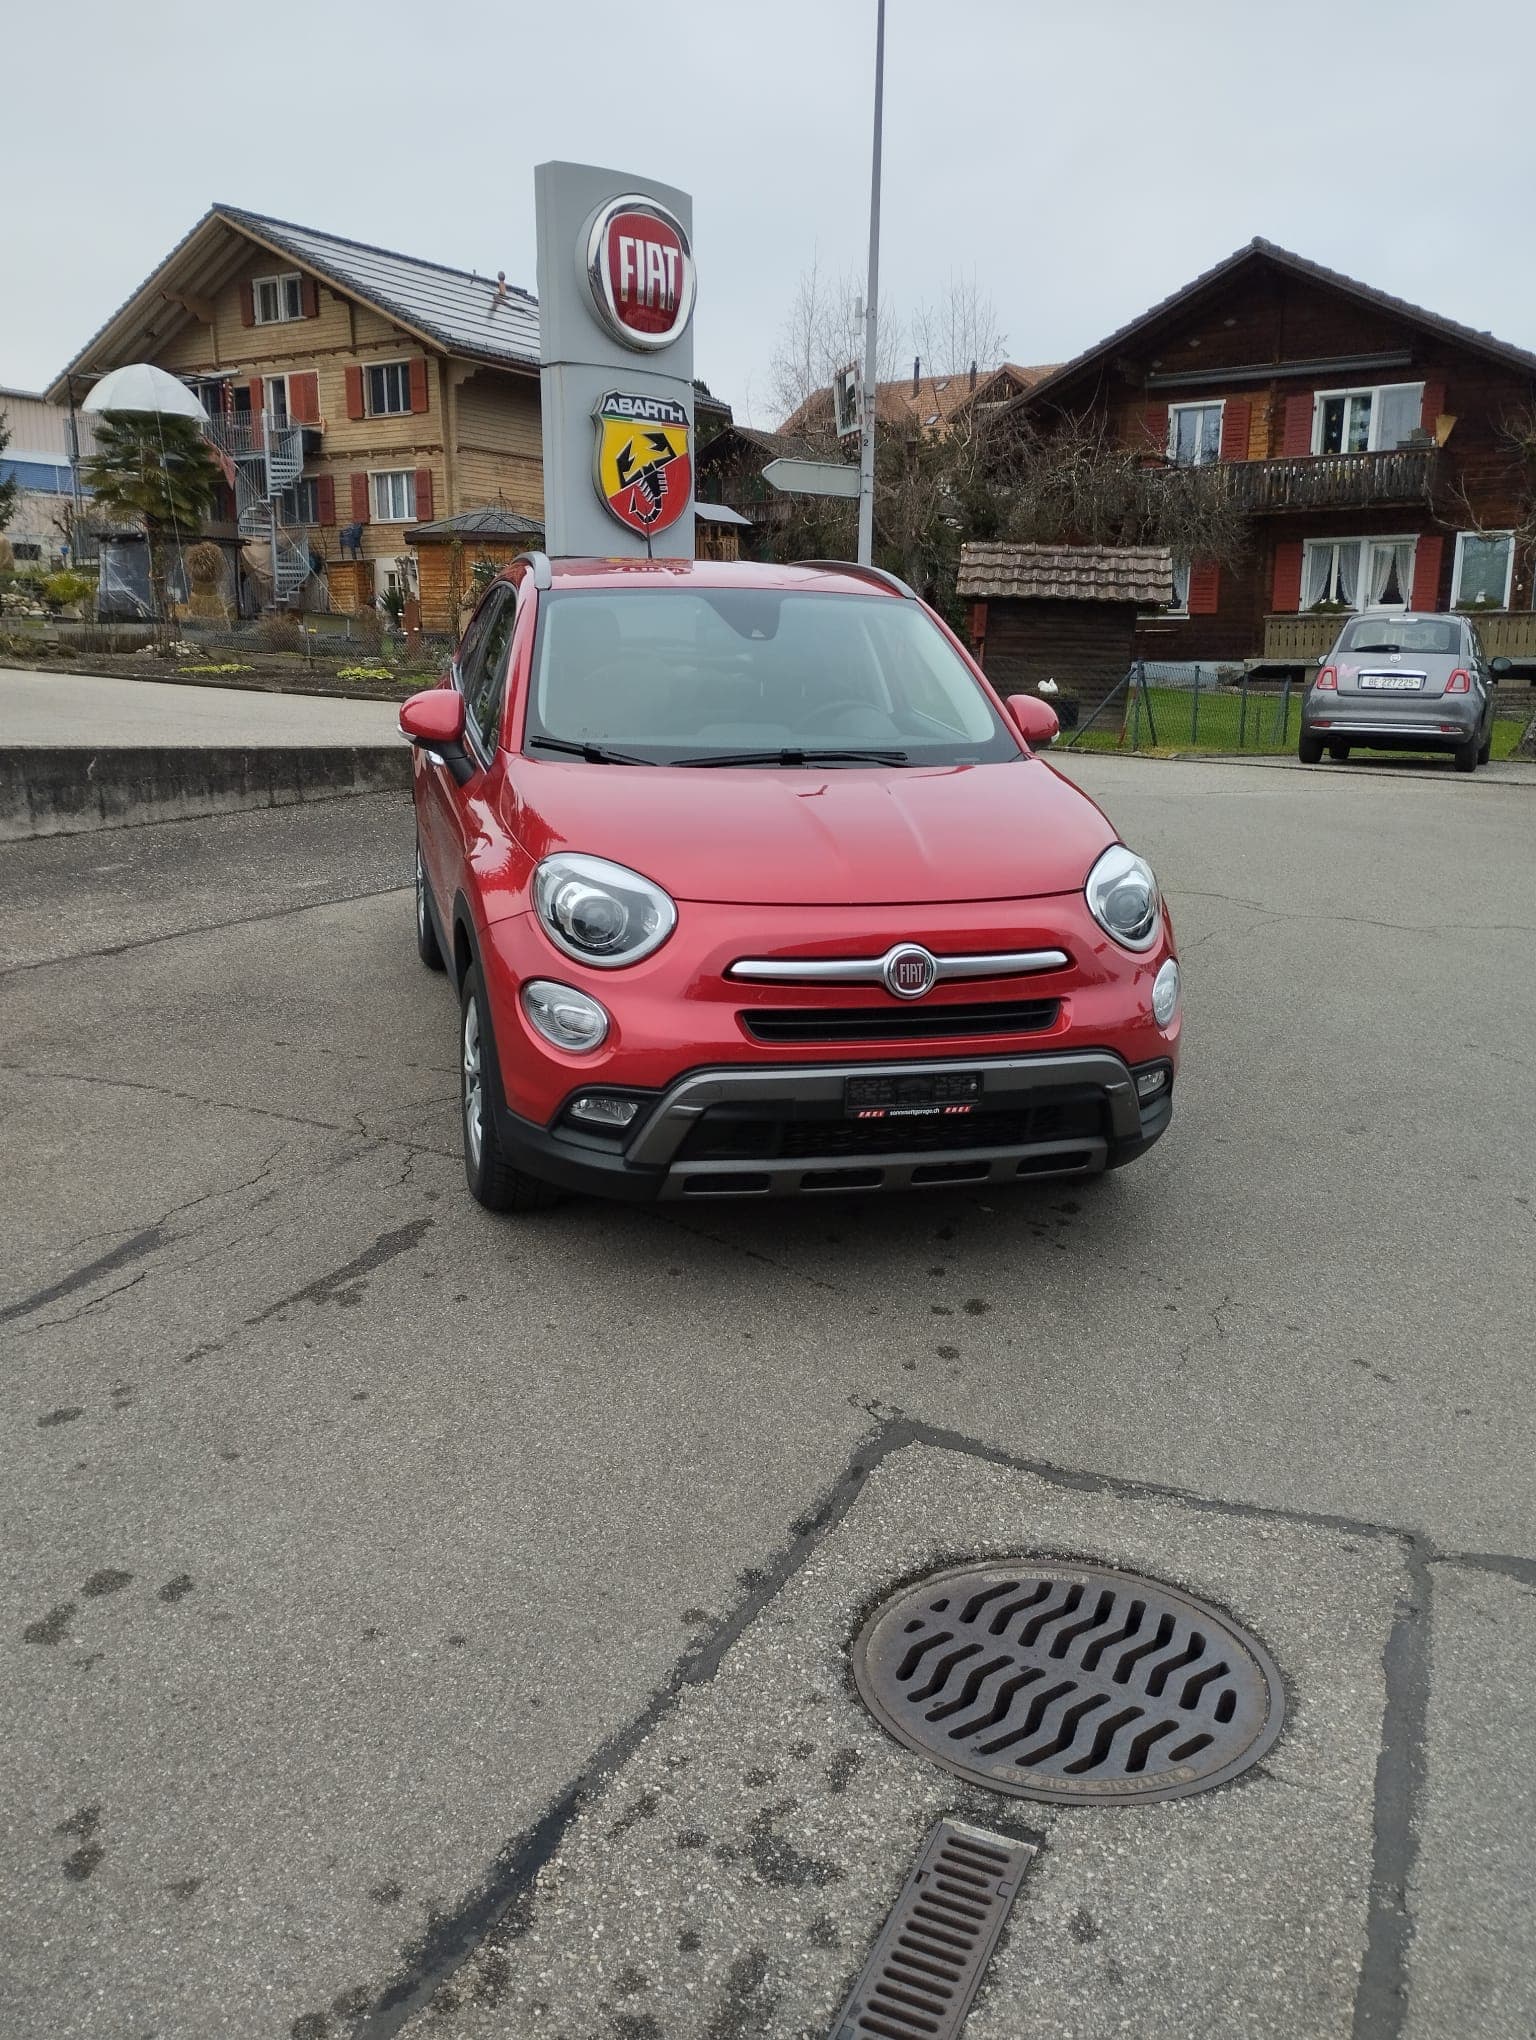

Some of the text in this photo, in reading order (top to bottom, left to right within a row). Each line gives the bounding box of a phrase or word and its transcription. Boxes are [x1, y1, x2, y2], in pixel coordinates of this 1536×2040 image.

[618, 234, 679, 312] FIAT
[604, 397, 684, 423] ABARTH
[863, 438, 870, 447] 2
[899, 962, 924, 984] FIAT
